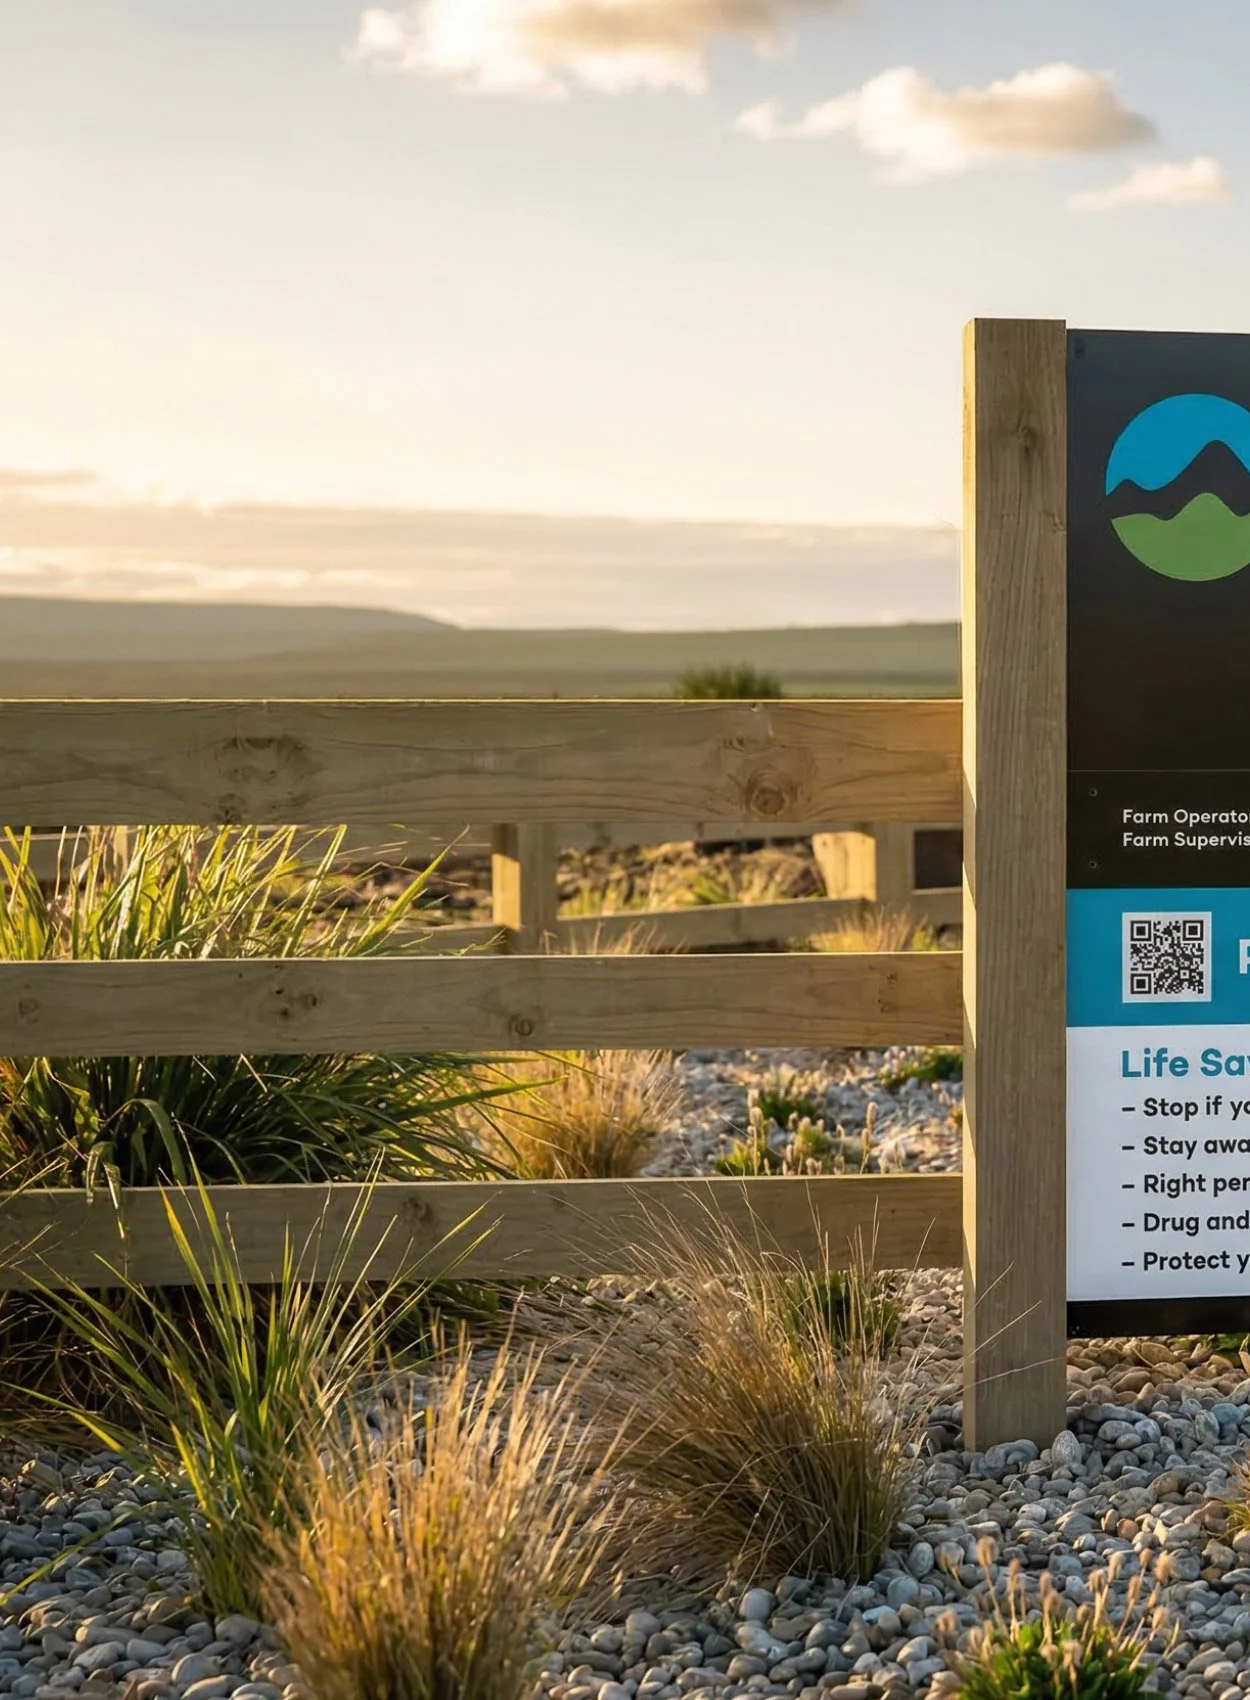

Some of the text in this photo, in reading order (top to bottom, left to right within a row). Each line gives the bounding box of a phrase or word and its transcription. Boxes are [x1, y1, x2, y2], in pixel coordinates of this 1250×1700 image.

[1123, 809, 1168, 823] Farm
[1123, 833, 1168, 846] Farm
[1122, 1048, 1189, 1077] Life
[1143, 1098, 1198, 1121] Stop
[1206, 1095, 1222, 1115] if
[1144, 1136, 1197, 1160] Stay
[1144, 1173, 1206, 1198] Right
[1144, 1213, 1199, 1236] Drug
[1207, 1210, 1249, 1230] and
[1144, 1251, 1230, 1271] Protect
